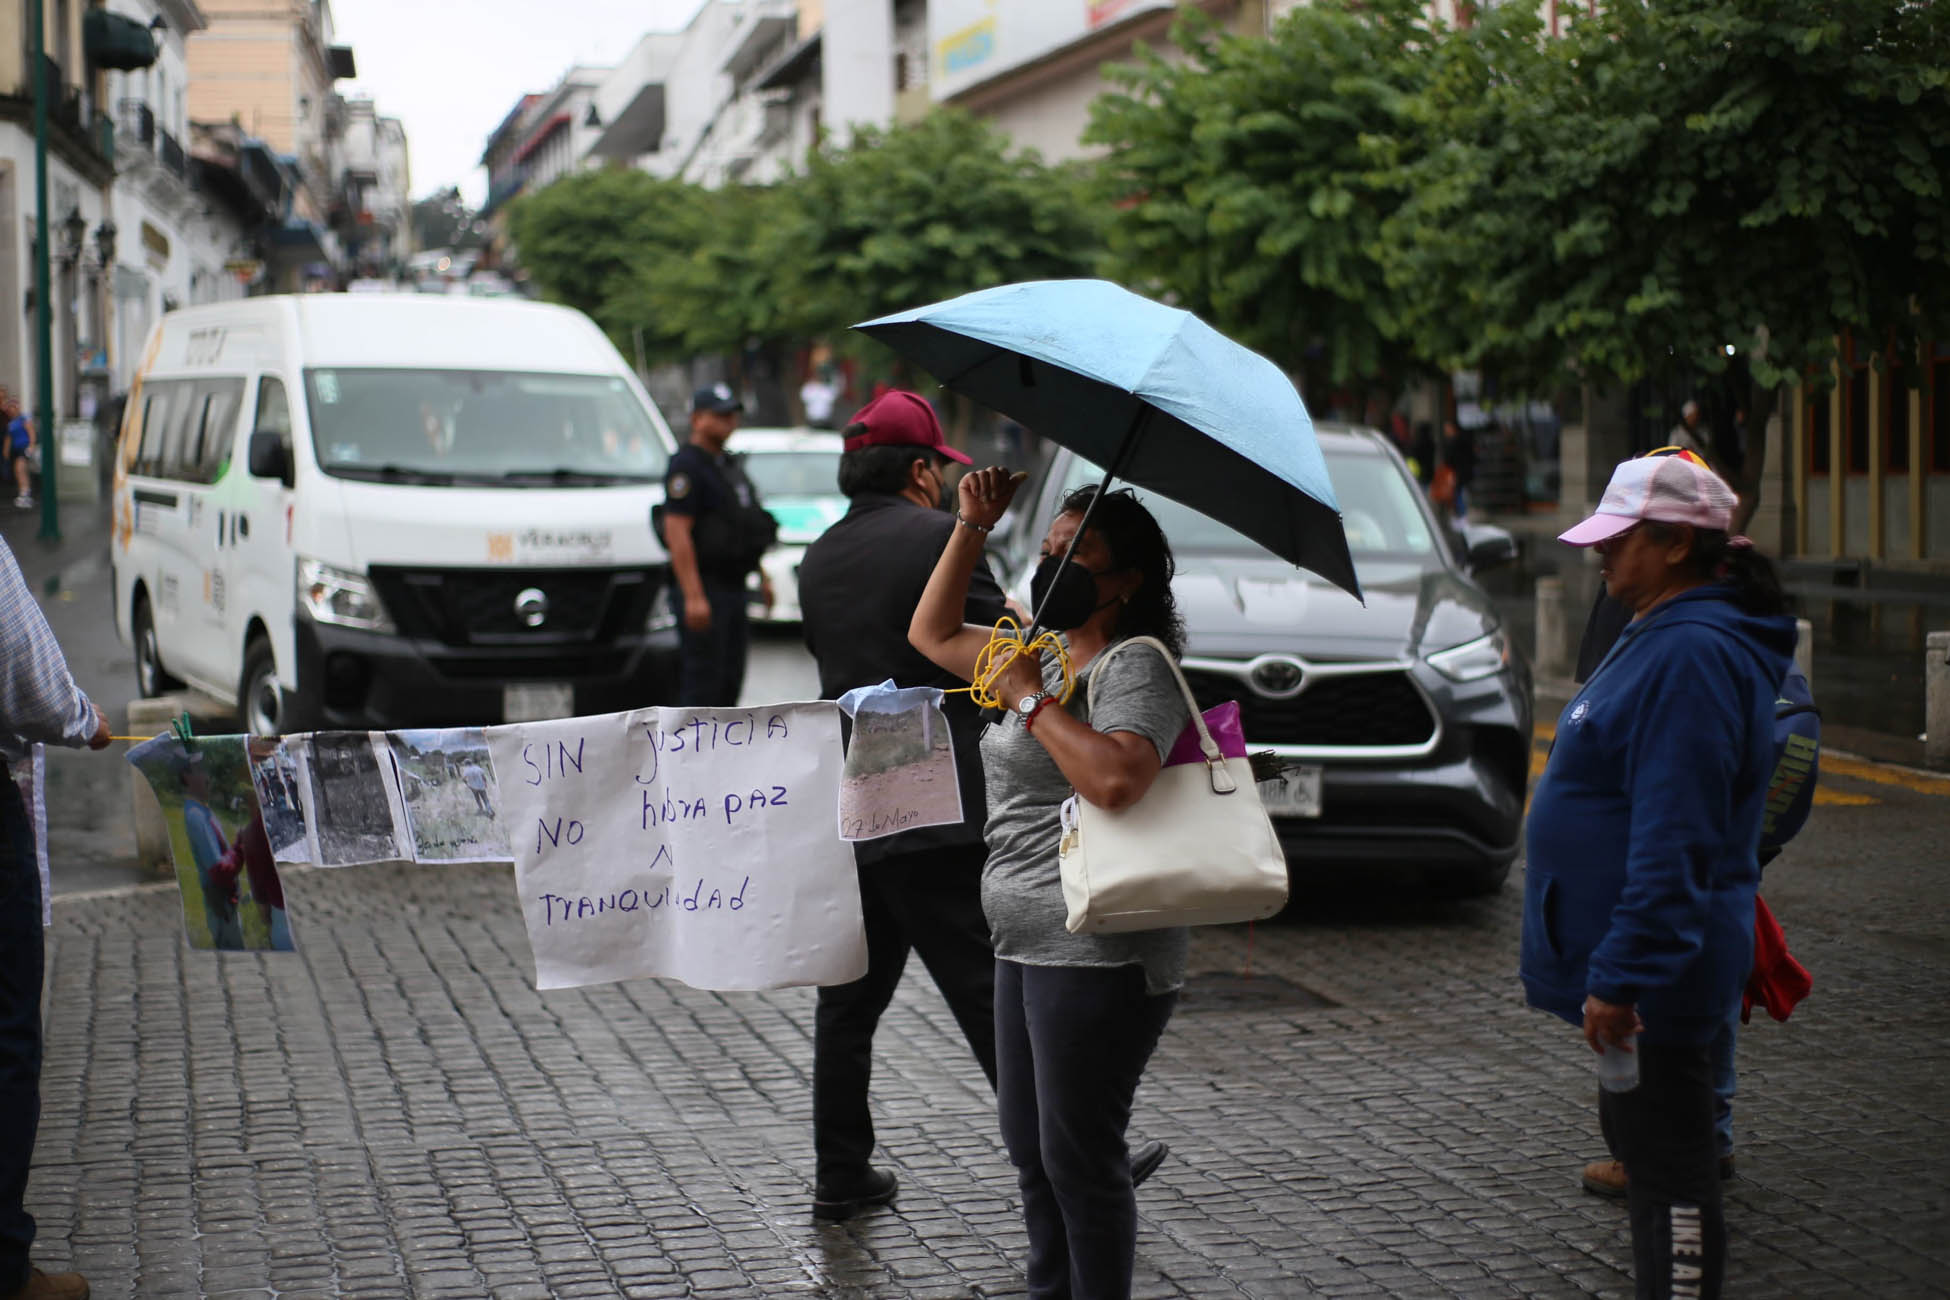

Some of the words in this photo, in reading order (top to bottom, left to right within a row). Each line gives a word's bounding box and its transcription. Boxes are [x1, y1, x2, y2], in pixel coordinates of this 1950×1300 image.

[523, 737, 585, 786] SIN
[536, 817, 584, 854] NO
[1670, 1206, 1702, 1256] LIKE
